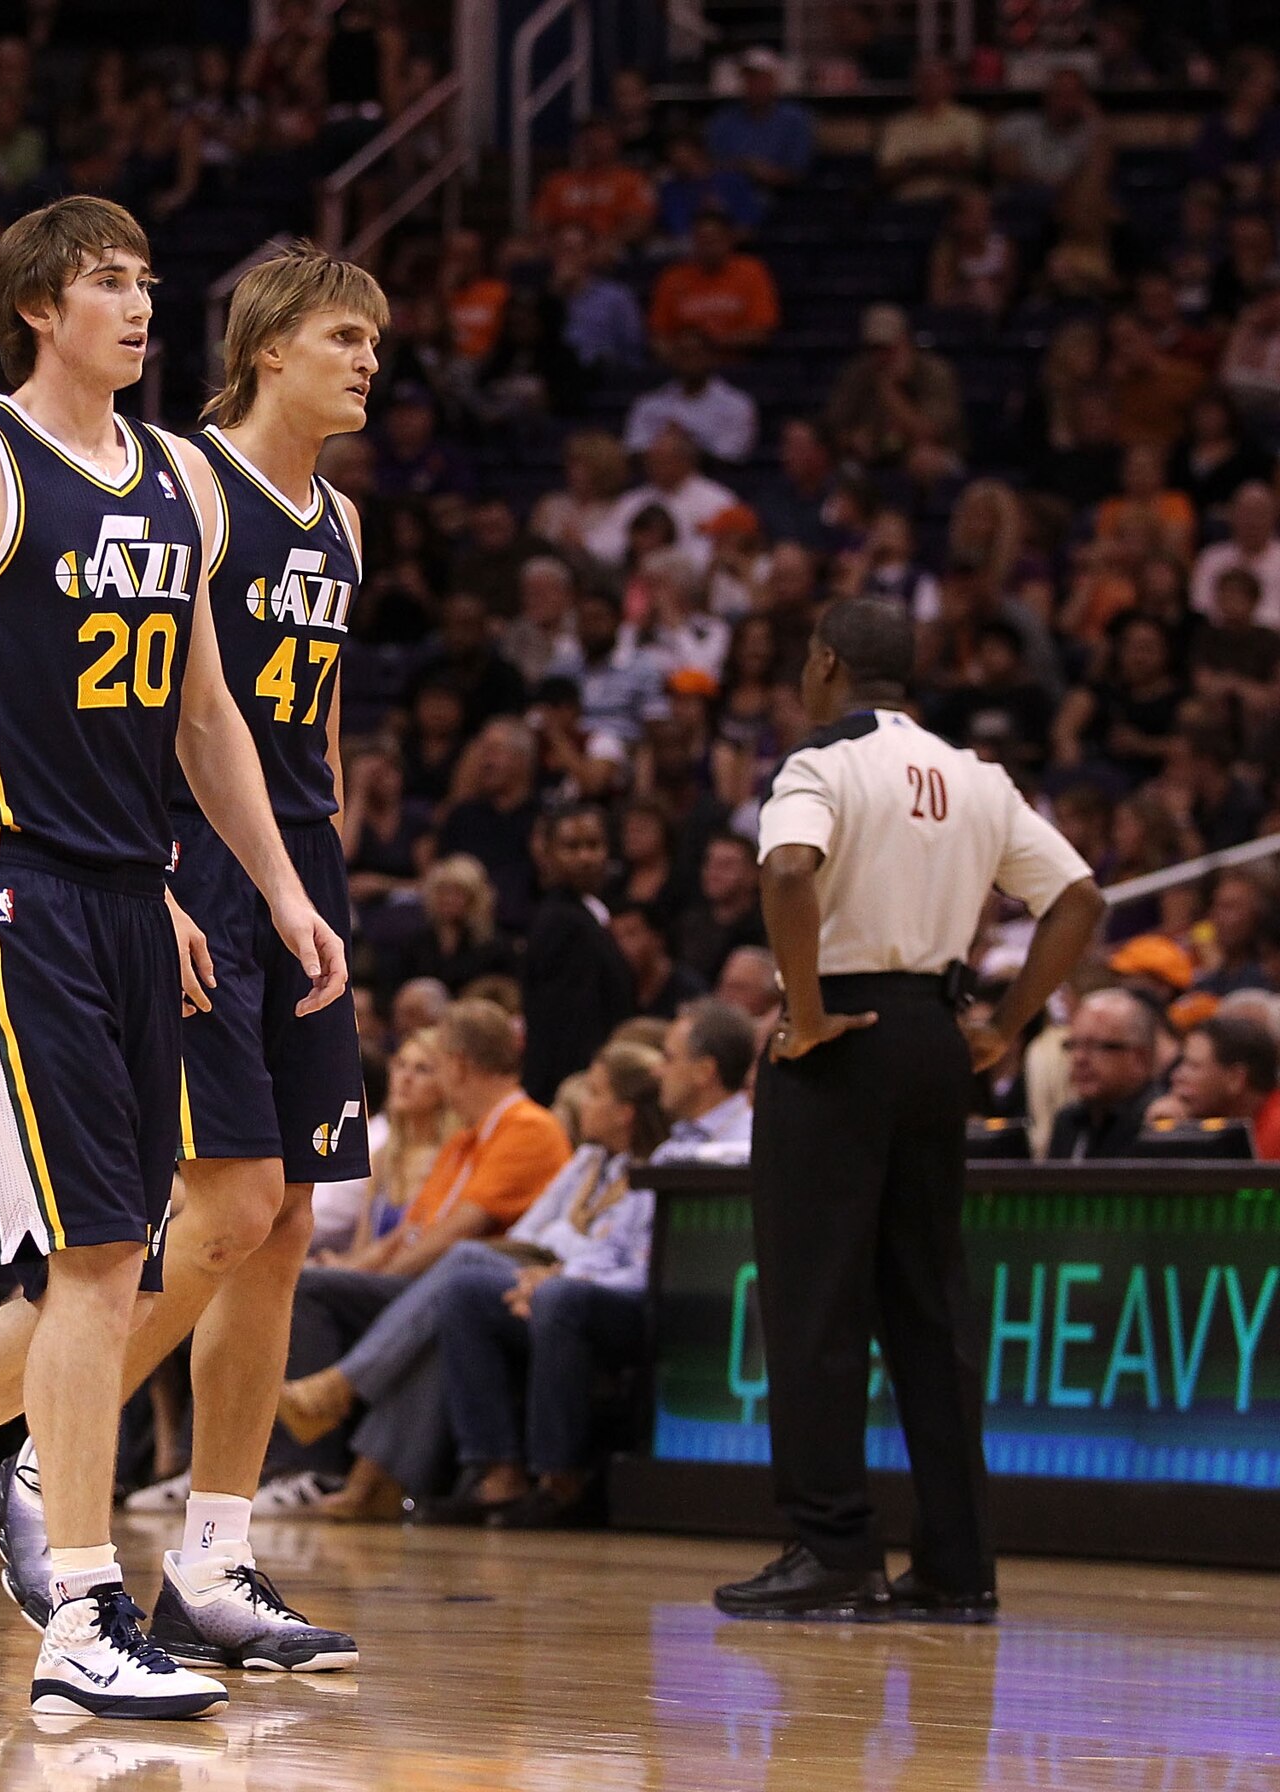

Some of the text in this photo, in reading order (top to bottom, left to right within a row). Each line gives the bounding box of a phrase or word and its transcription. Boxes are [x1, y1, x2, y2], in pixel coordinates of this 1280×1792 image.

[84, 514, 191, 602] JAZZ
[269, 547, 352, 634] JAZZ
[77, 612, 178, 710] 20
[255, 636, 341, 725] 47
[906, 765, 947, 822] 20
[983, 1262, 1280, 1413] HEAVY
